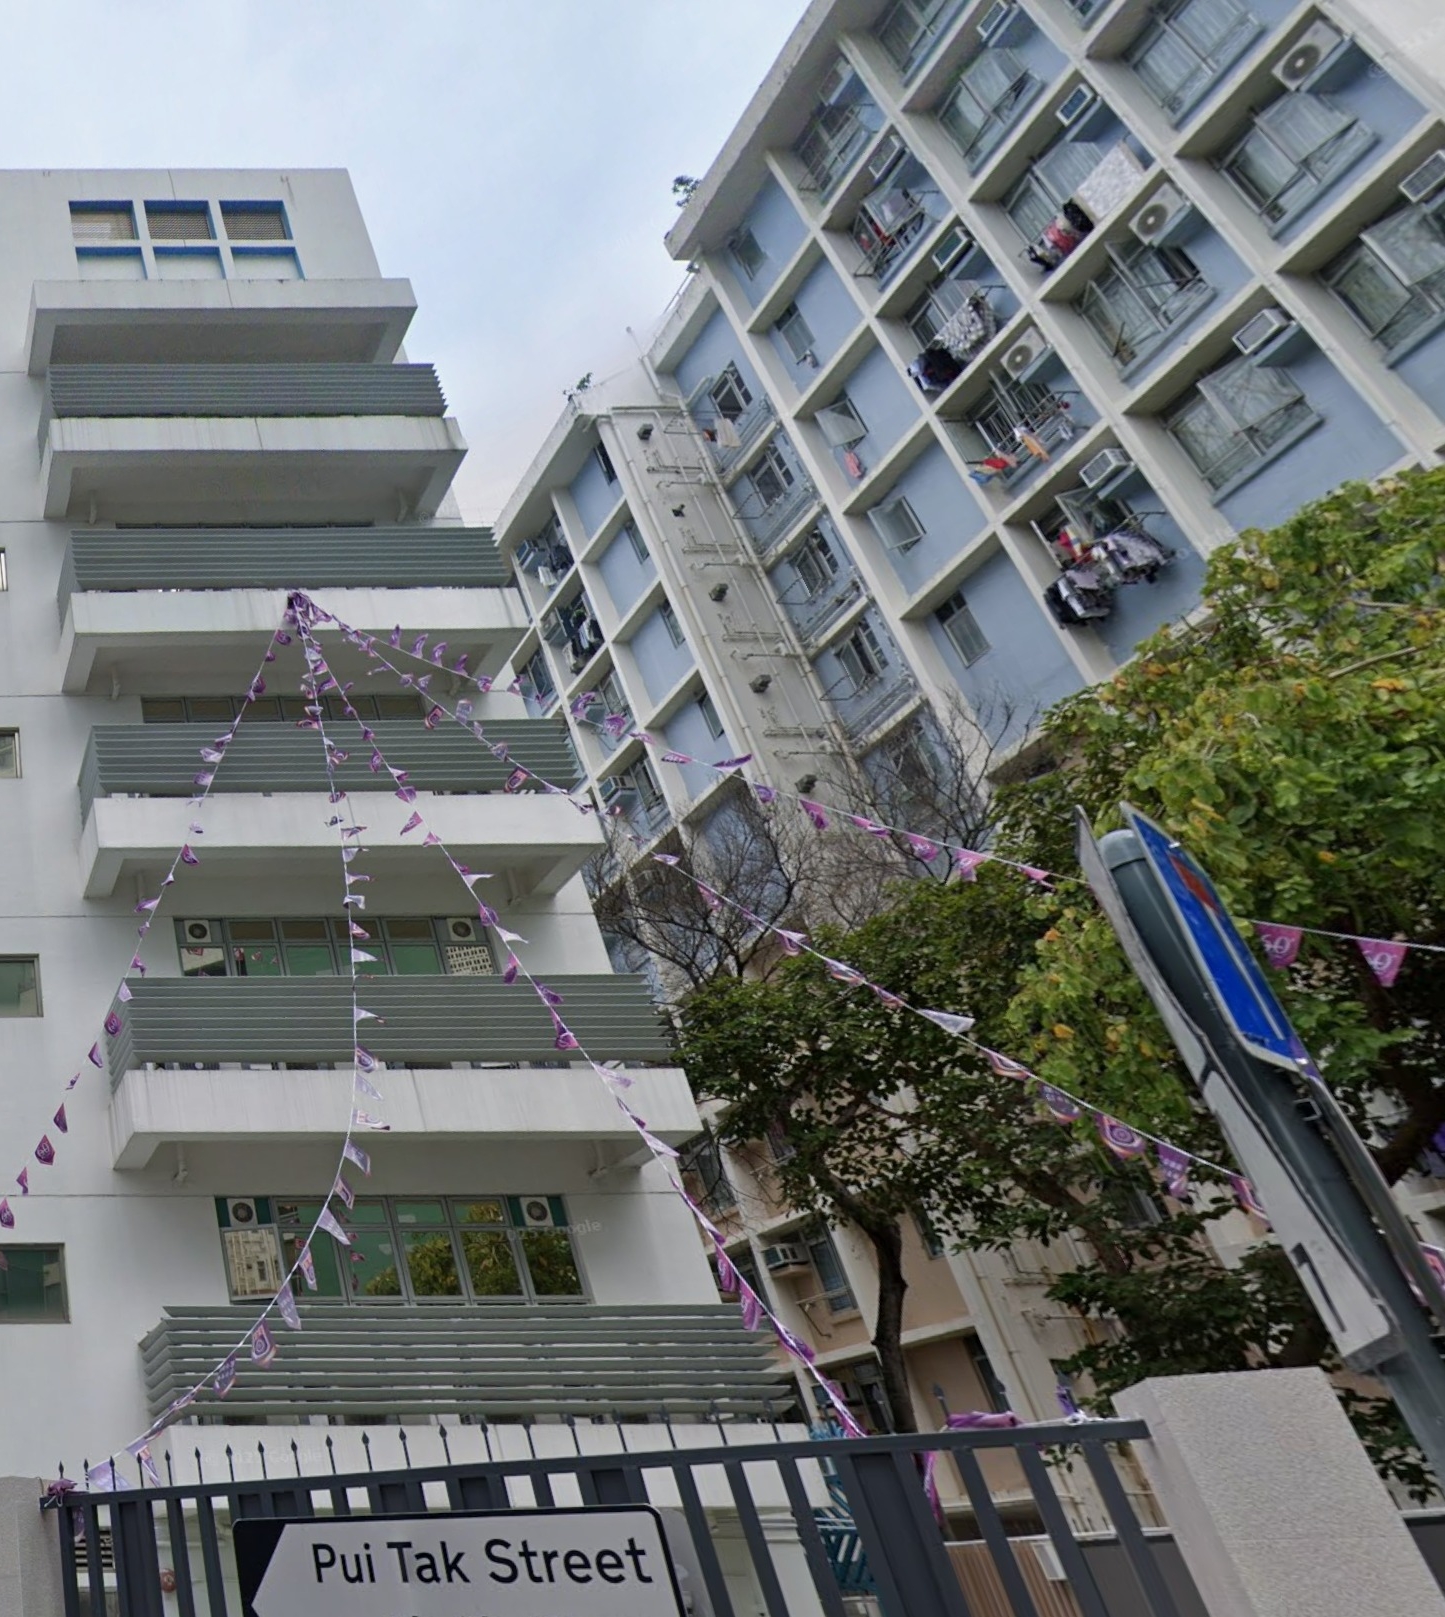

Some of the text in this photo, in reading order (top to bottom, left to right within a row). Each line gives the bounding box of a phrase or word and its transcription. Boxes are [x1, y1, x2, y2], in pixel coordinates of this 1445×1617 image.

[311, 1537, 653, 1585] Pui Tak Street
